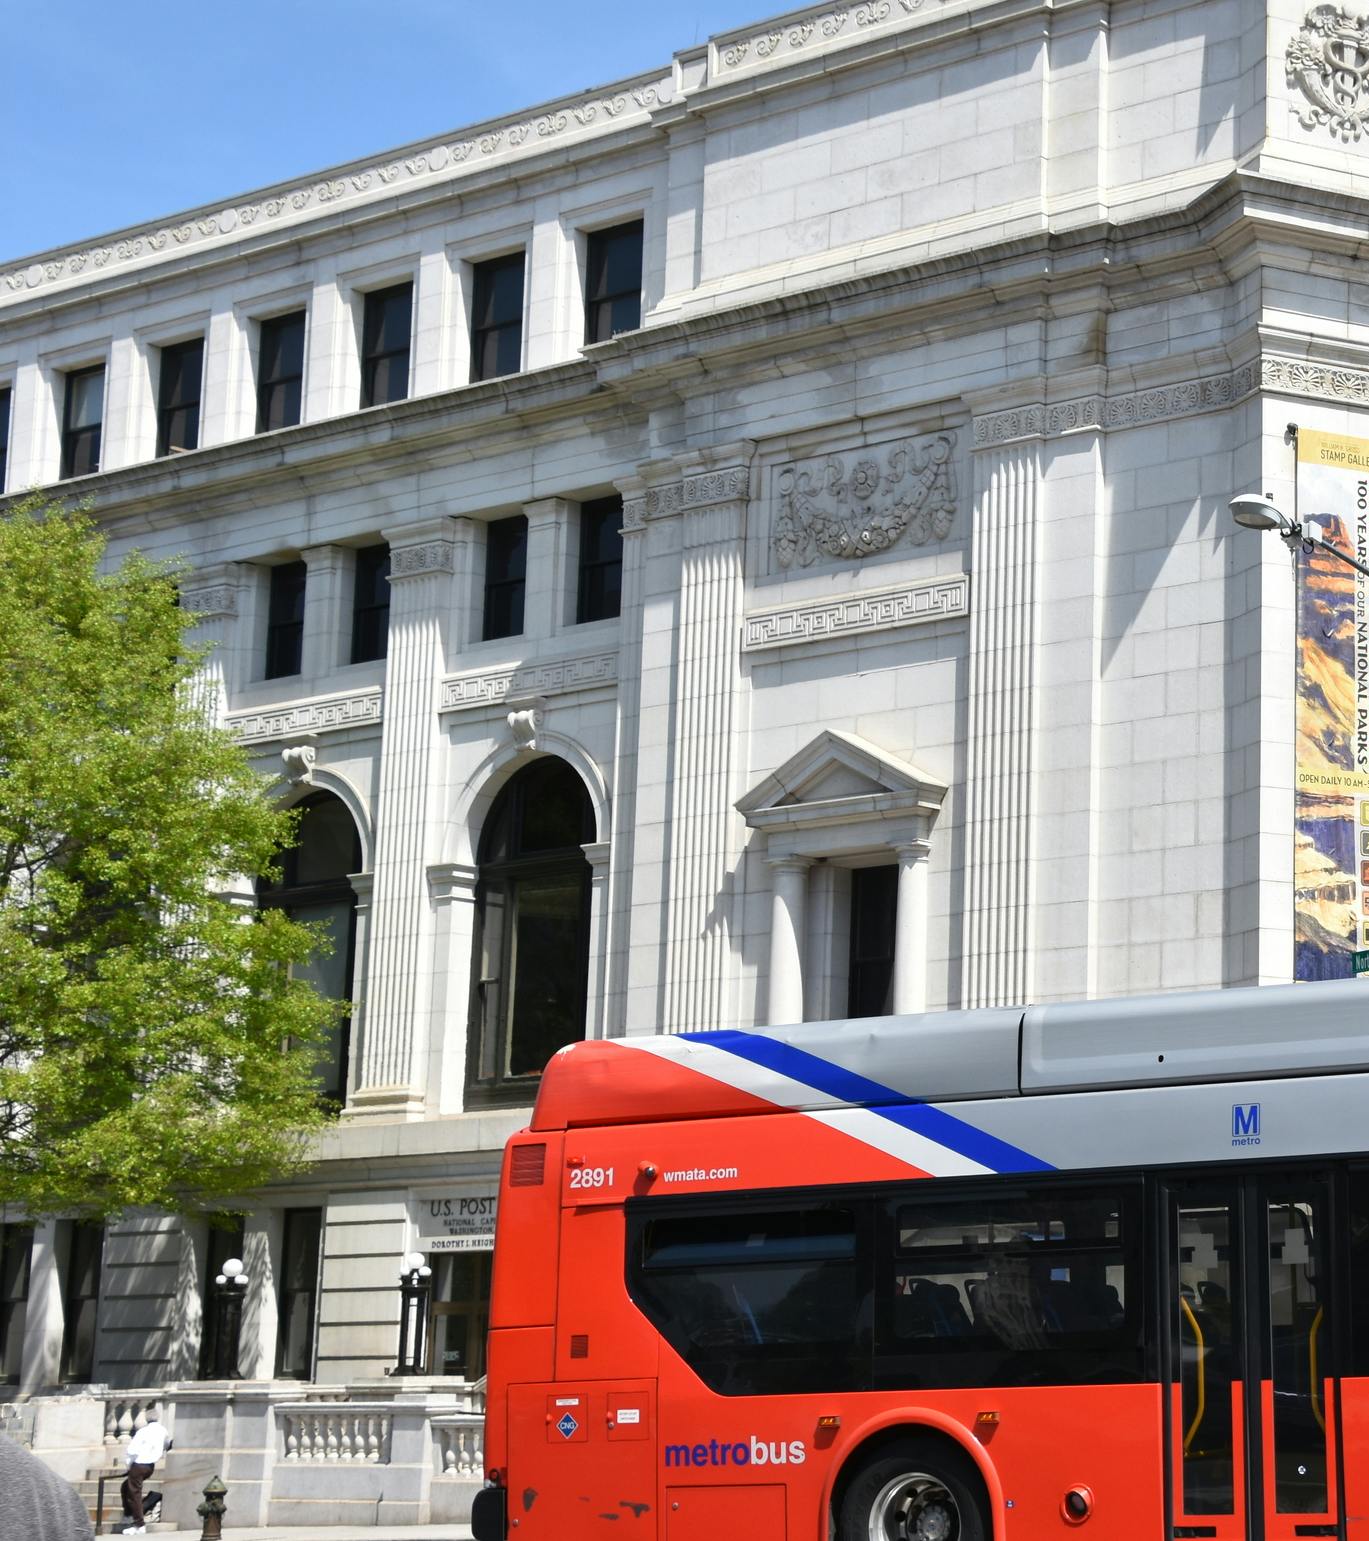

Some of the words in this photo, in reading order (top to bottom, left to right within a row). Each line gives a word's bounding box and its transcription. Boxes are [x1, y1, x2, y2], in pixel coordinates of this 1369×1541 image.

[1320, 449, 1346, 462] STAMP
[1357, 480, 1368, 509] 100
[1357, 514, 1367, 568] YEARS
[1357, 591, 1365, 617] OUR
[1357, 621, 1368, 703] NATIONAL
[1357, 708, 1368, 765] PARKS
[1299, 773, 1319, 784] OPEN
[1320, 776, 1342, 785] DAILY
[1344, 778, 1352, 787] 10
[1234, 1105, 1258, 1135] M
[1232, 1137, 1260, 1146] metro
[570, 1167, 614, 1189] 2891
[663, 1166, 738, 1183] wmata.com
[430, 1199, 454, 1217] U.S.
[459, 1196, 496, 1216] POST
[559, 1421, 575, 1430] CNG
[665, 1435, 806, 1467] metrobus
